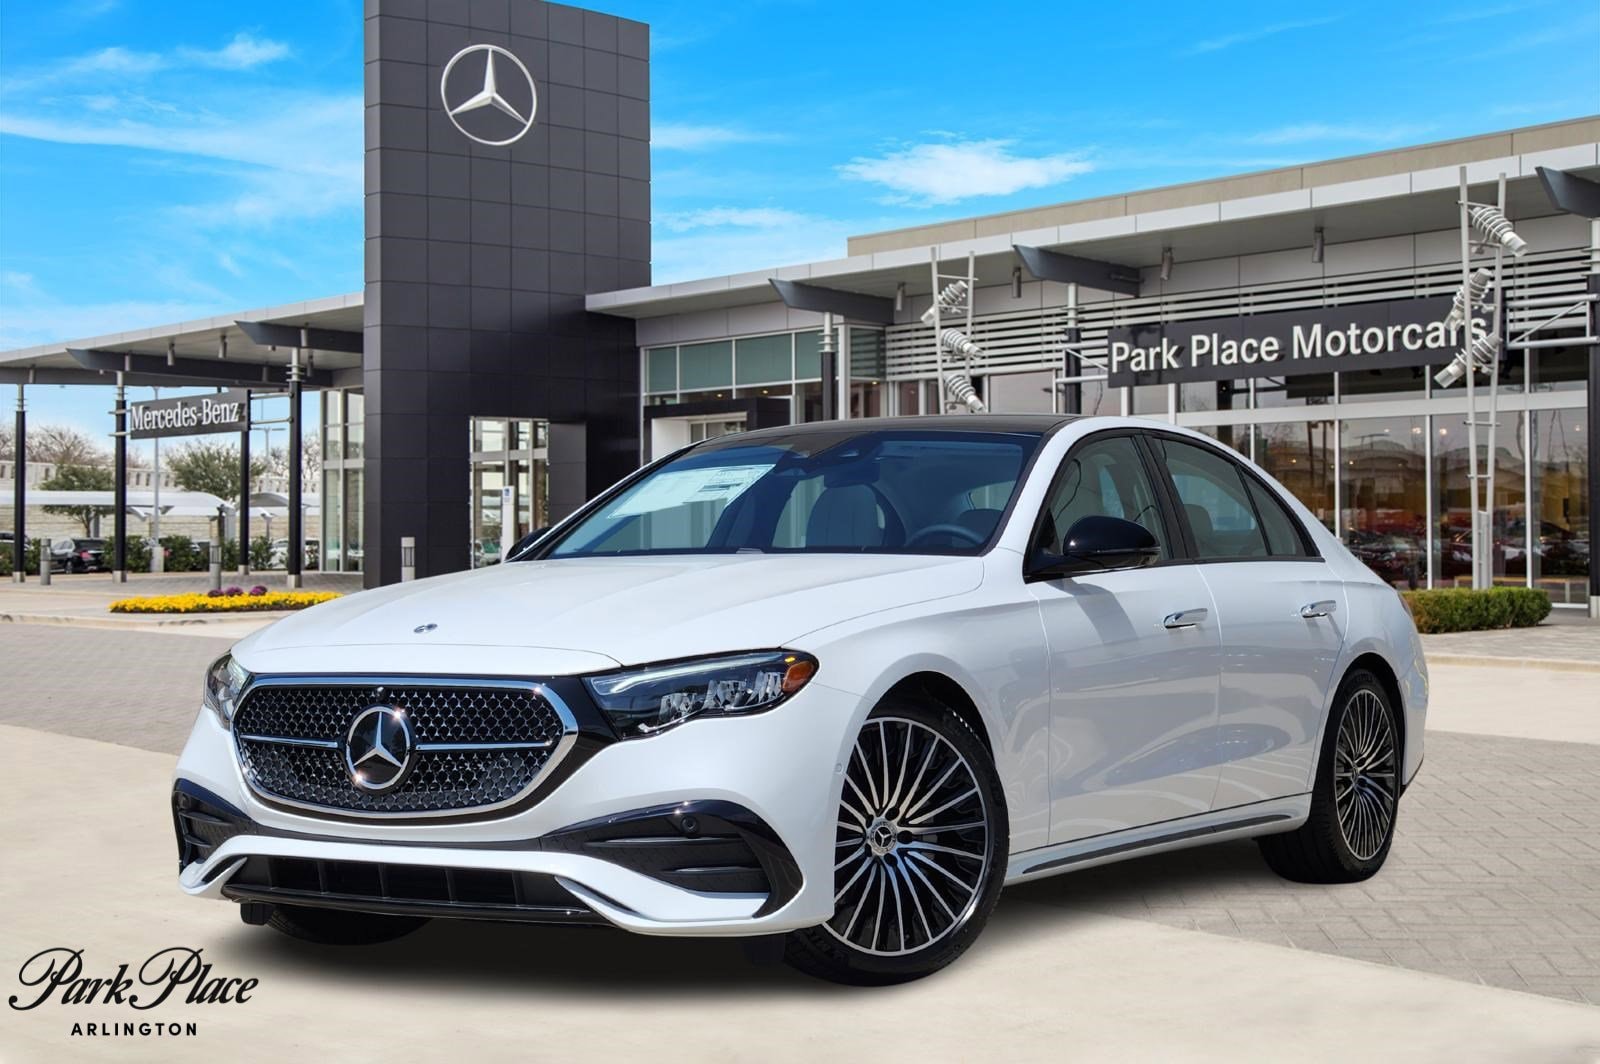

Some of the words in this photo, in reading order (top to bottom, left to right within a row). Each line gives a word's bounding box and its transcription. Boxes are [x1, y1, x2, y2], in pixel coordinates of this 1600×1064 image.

[1111, 337, 1179, 373] Park
[1191, 331, 1279, 367] Place
[131, 398, 240, 431] Mercedes-Benz
